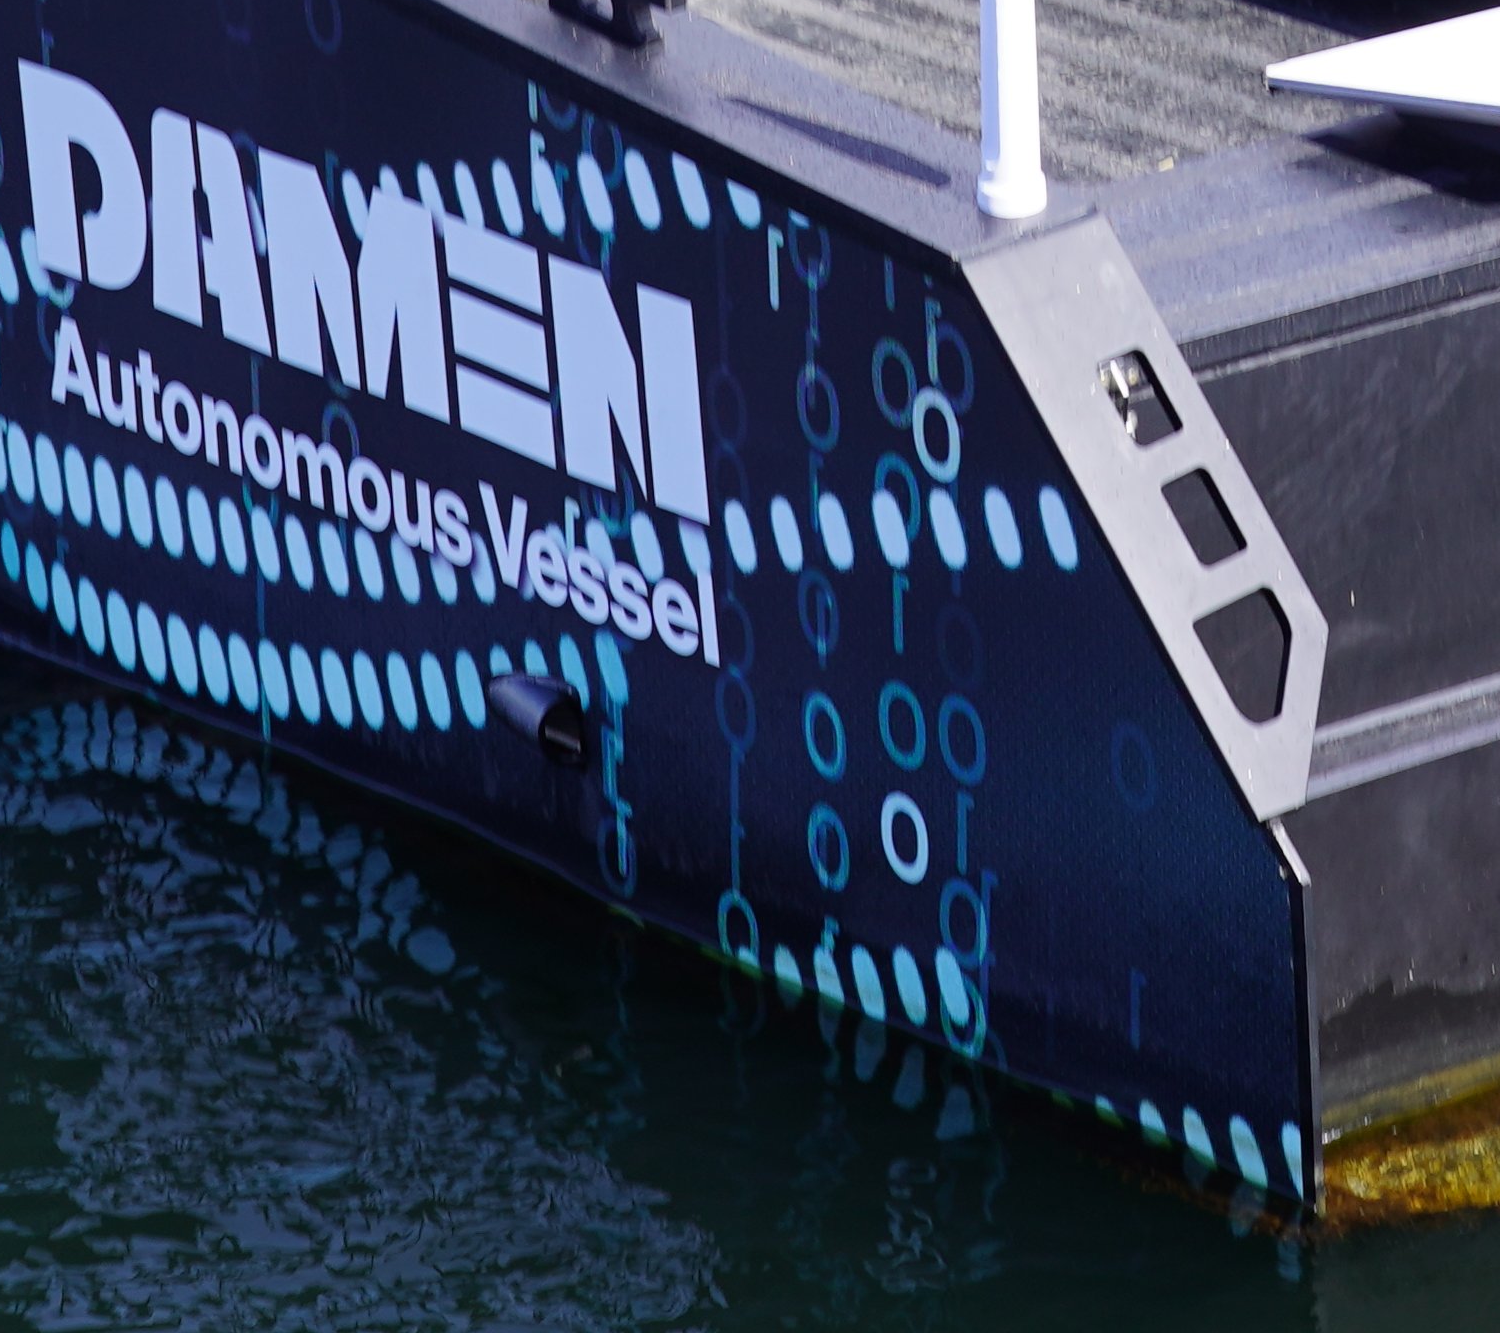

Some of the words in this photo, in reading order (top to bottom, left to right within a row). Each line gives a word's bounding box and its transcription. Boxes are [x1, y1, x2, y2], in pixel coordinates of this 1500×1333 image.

[18, 57, 711, 527] DAMEN
[51, 316, 475, 571] Autonomous
[479, 480, 722, 668] Vessel
